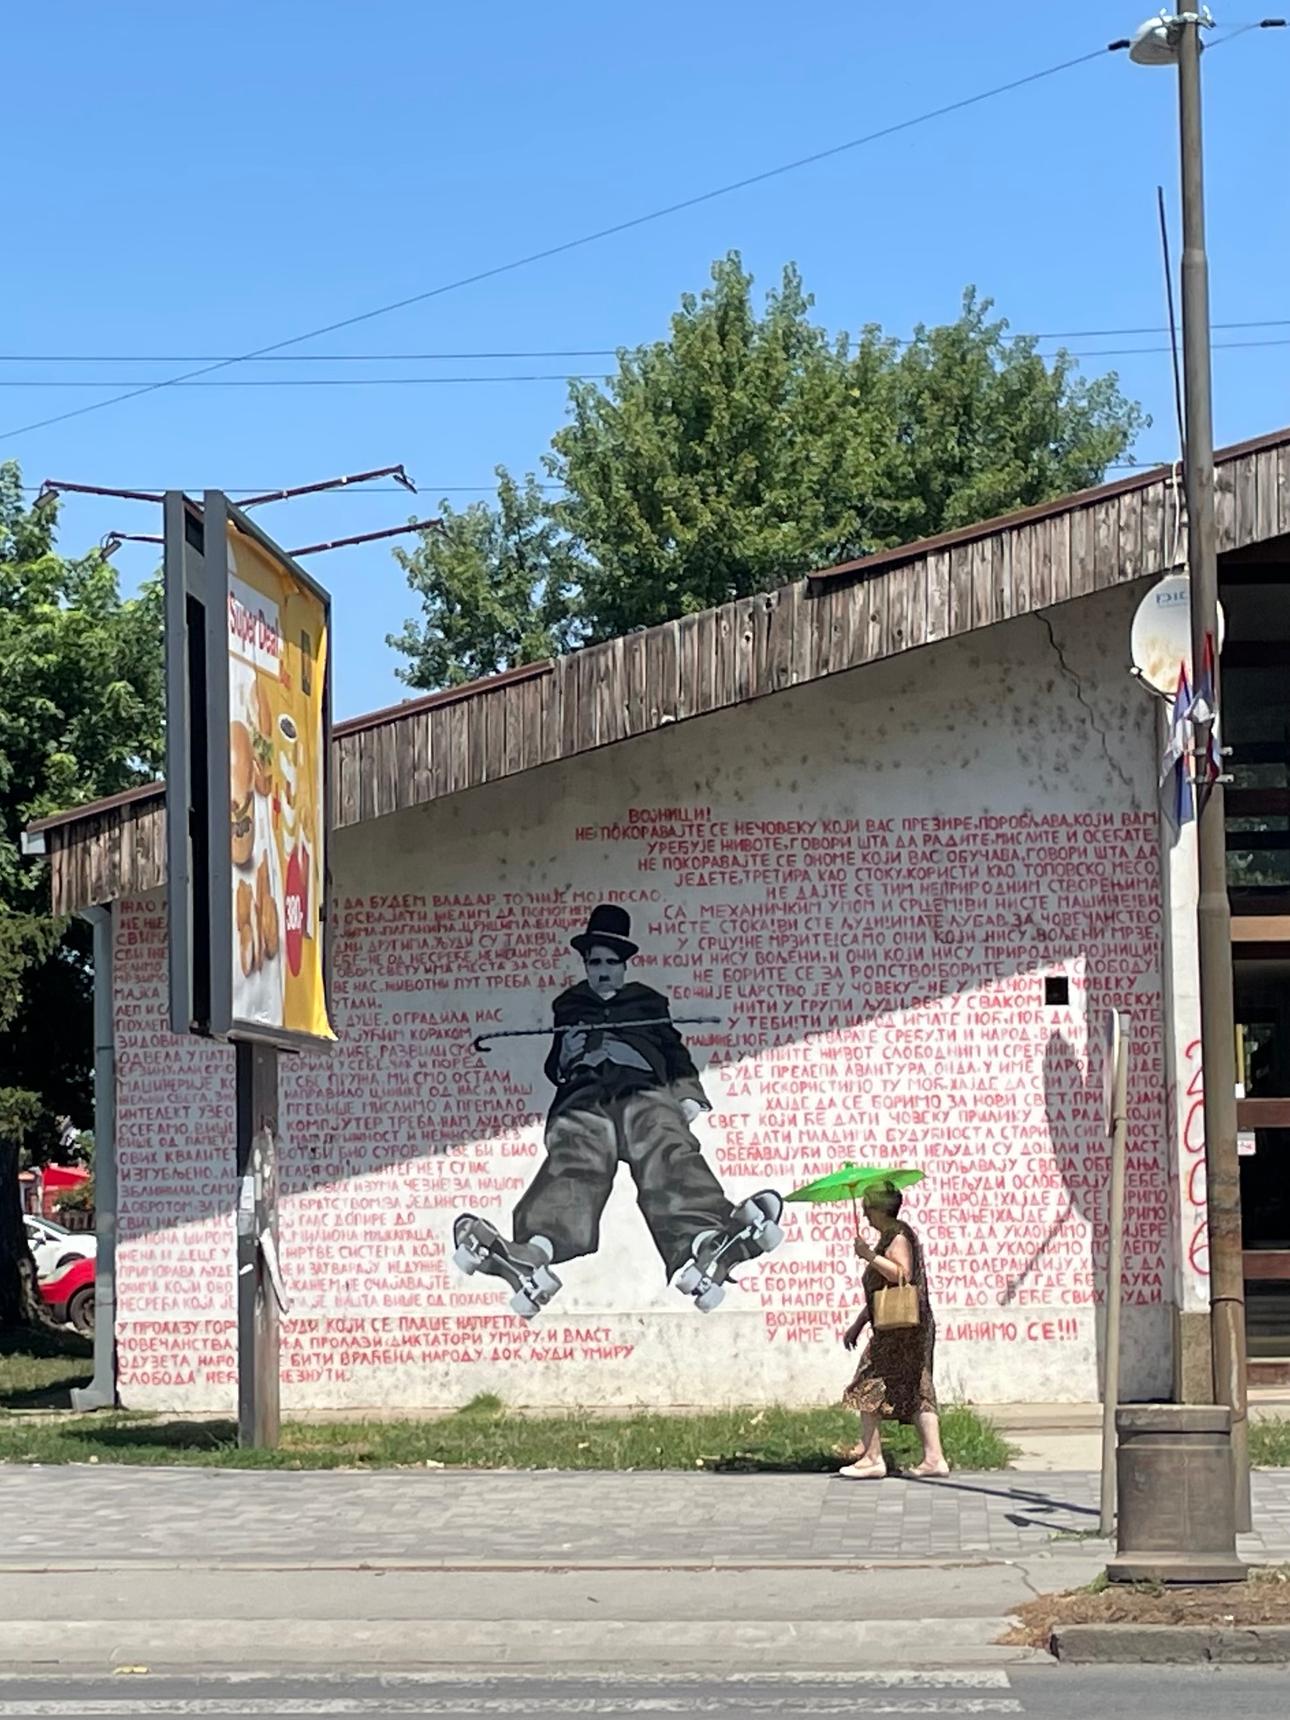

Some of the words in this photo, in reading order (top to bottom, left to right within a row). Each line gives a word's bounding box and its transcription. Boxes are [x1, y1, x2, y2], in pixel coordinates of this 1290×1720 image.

[629, 807, 711, 823] ВОЈНИЦИ!
[576, 827, 594, 840] НЕ
[600, 823, 705, 839] ПОКОРАВАЈТЕ
[710, 822, 728, 836] СЕ
[735, 820, 817, 835] НЕЧОВЕКУ
[822, 819, 860, 833] КОЈИ
[865, 819, 894, 832] ВАС
[1121, 812, 1158, 826] ВАМ
[858, 834, 888, 848] ШТА
[896, 834, 918, 848] ДА
[638, 857, 657, 871] НЕ
[662, 853, 770, 870] ПОКОРАВАЈТЕ
[777, 852, 798, 867] СЕ
[803, 851, 855, 867] ОНОМЕ
[862, 850, 901, 865] КОЈИ
[908, 850, 942, 864] ВАС
[1093, 846, 1129, 860] ШТА
[1135, 846, 1160, 860] ДА
[817, 868, 847, 882] КАО
[987, 864, 1016, 878] КАО
[1024, 861, 1104, 877] ТОПОВСКО
[767, 886, 788, 900] НЕ
[796, 884, 847, 900] ДАЈТЕ
[854, 883, 873, 897] СЕ
[882, 882, 913, 896] ТИМ
[920, 880, 1040, 896] НЕПРИРОДНИМ
[369, 894, 426, 909] БУДЕМ
[432, 892, 496, 907] ВЛАДАР
[664, 904, 686, 920] СА
[701, 901, 824, 918] МЕХАНИЧКИМ
[830, 899, 874, 914] УМОМ
[995, 897, 1048, 910] НИСТЕ
[649, 920, 711, 936] НИСТЕ
[804, 916, 833, 930] СТЕ
[1013, 913, 1034, 927] ЗА
[1041, 911, 1160, 927] ЧОВЕЧАНСТВО
[479, 934, 497, 947] СУ
[893, 932, 926, 945] ОНИ
[986, 929, 1027, 943] НИСУ
[663, 953, 703, 967] КОЈИ
[710, 952, 748, 967] НИСУ
[846, 949, 877, 963] ОНИ
[884, 948, 924, 962] КОЈИ
[931, 946, 973, 960] НИСУ
[694, 969, 712, 982] НЕ
[723, 967, 787, 982] БОРИТЕ
[796, 966, 815, 980] СЕ
[822, 965, 843, 980] ЗА
[1074, 958, 1160, 975] СЛОБОДУ!
[455, 977, 480, 989] ПУТ
[487, 975, 531, 988] ТРЕБА
[538, 974, 555, 988] ДА
[737, 983, 806, 999] ЦАРСТВО
[812, 982, 831, 996] ЈЕ
[1071, 976, 1138, 992] ЧОВЕКУ
[733, 1000, 778, 1014] НИТИ
[801, 999, 852, 1011] ГРУПИ
[967, 992, 1042, 1008] СВАКОМ
[1090, 991, 1160, 1007] ЧОВЕКУ!
[392, 1011, 469, 1024] ОГРАДИЛА
[476, 1008, 503, 1022] НАС
[432, 1057, 486, 1069] ПОРЕД
[771, 1064, 838, 1079] ПРЕЛЕПА
[999, 1060, 1033, 1073] ИМЕ
[414, 1071, 446, 1085] СМО
[452, 1070, 511, 1083] ОСТАЛИ
[429, 1086, 452, 1097] ОД
[727, 1082, 751, 1096] ДА
[882, 1078, 901, 1091] ТУ
[815, 1097, 836, 1110] ДА
[843, 1096, 860, 1110] СЕ
[872, 1094, 941, 1107] БОРИМО
[951, 1093, 967, 1107] ЗА
[974, 1092, 1016, 1106] НОВИ
[119, 1106, 190, 1120] ИНТЕЛЕКТ
[199, 1105, 234, 1118] УЗЕО
[708, 1114, 750, 1129] СВЕТ
[759, 1113, 797, 1128] КОЈИ
[834, 1111, 879, 1126] ДАТИ
[889, 1110, 950, 1124] ЧОВЕКУ
[286, 1118, 382, 1131] КОМПЈУТЕР
[388, 1115, 434, 1130] ТРЕБА
[441, 1116, 470, 1128] НАМ
[749, 1131, 792, 1145] ДАТИ
[501, 1143, 538, 1156] БИЛО
[827, 1146, 856, 1160] ОВЕ
[993, 1143, 1013, 1157] СУ
[1027, 1157, 1078, 1173] СВОЈА
[395, 1212, 415, 1226] ДО
[184, 1231, 233, 1243] ШИРОМ
[975, 1224, 998, 1238] ДА
[1004, 1223, 1086, 1239] УКЛОНИМО
[413, 1243, 446, 1257] КОЈИ
[967, 1241, 988, 1255] ДА
[997, 1241, 1083, 1255] УКЛОНИМО
[758, 1261, 846, 1275] УКЛОНИМО
[1141, 1258, 1165, 1271] ДА
[165, 1282, 201, 1293] КОЈИ
[207, 1280, 233, 1293] ОВО
[740, 1279, 760, 1292] СЕ
[766, 1277, 835, 1291] БОРИМО
[1034, 1273, 1066, 1287] ГДЕ
[427, 1295, 446, 1306] ОД
[450, 1292, 508, 1307] ПОХЛЕПЕ
[964, 1291, 988, 1306] ДО
[1061, 1289, 1104, 1304] СВИХ
[326, 1318, 364, 1333] КОЈИ
[371, 1317, 393, 1332] СЕ
[400, 1316, 449, 1331] ПЛАШЕ
[766, 1312, 850, 1327] ВОЈНИЦИ!
[118, 1321, 128, 1335] У
[134, 1321, 200, 1334] ПРОЛАЗУ
[767, 1328, 778, 1342] У
[787, 1327, 822, 1341] ИМЕ
[1027, 1319, 1079, 1341] СЕ!!!
[310, 1337, 382, 1348] ПРОЛАЗИ
[564, 1328, 611, 1342] ВЛАСТ
[118, 1354, 190, 1368] ОДУЗЕТА
[290, 1354, 333, 1366] БИТИ
[340, 1352, 415, 1365] ВРАЋЕНА
[490, 1350, 521, 1361] ДОК
[530, 1349, 574, 1361] ЉУДИ
[583, 1345, 634, 1360] УМИРУ
[118, 1371, 196, 1385] СЛОБОДА
